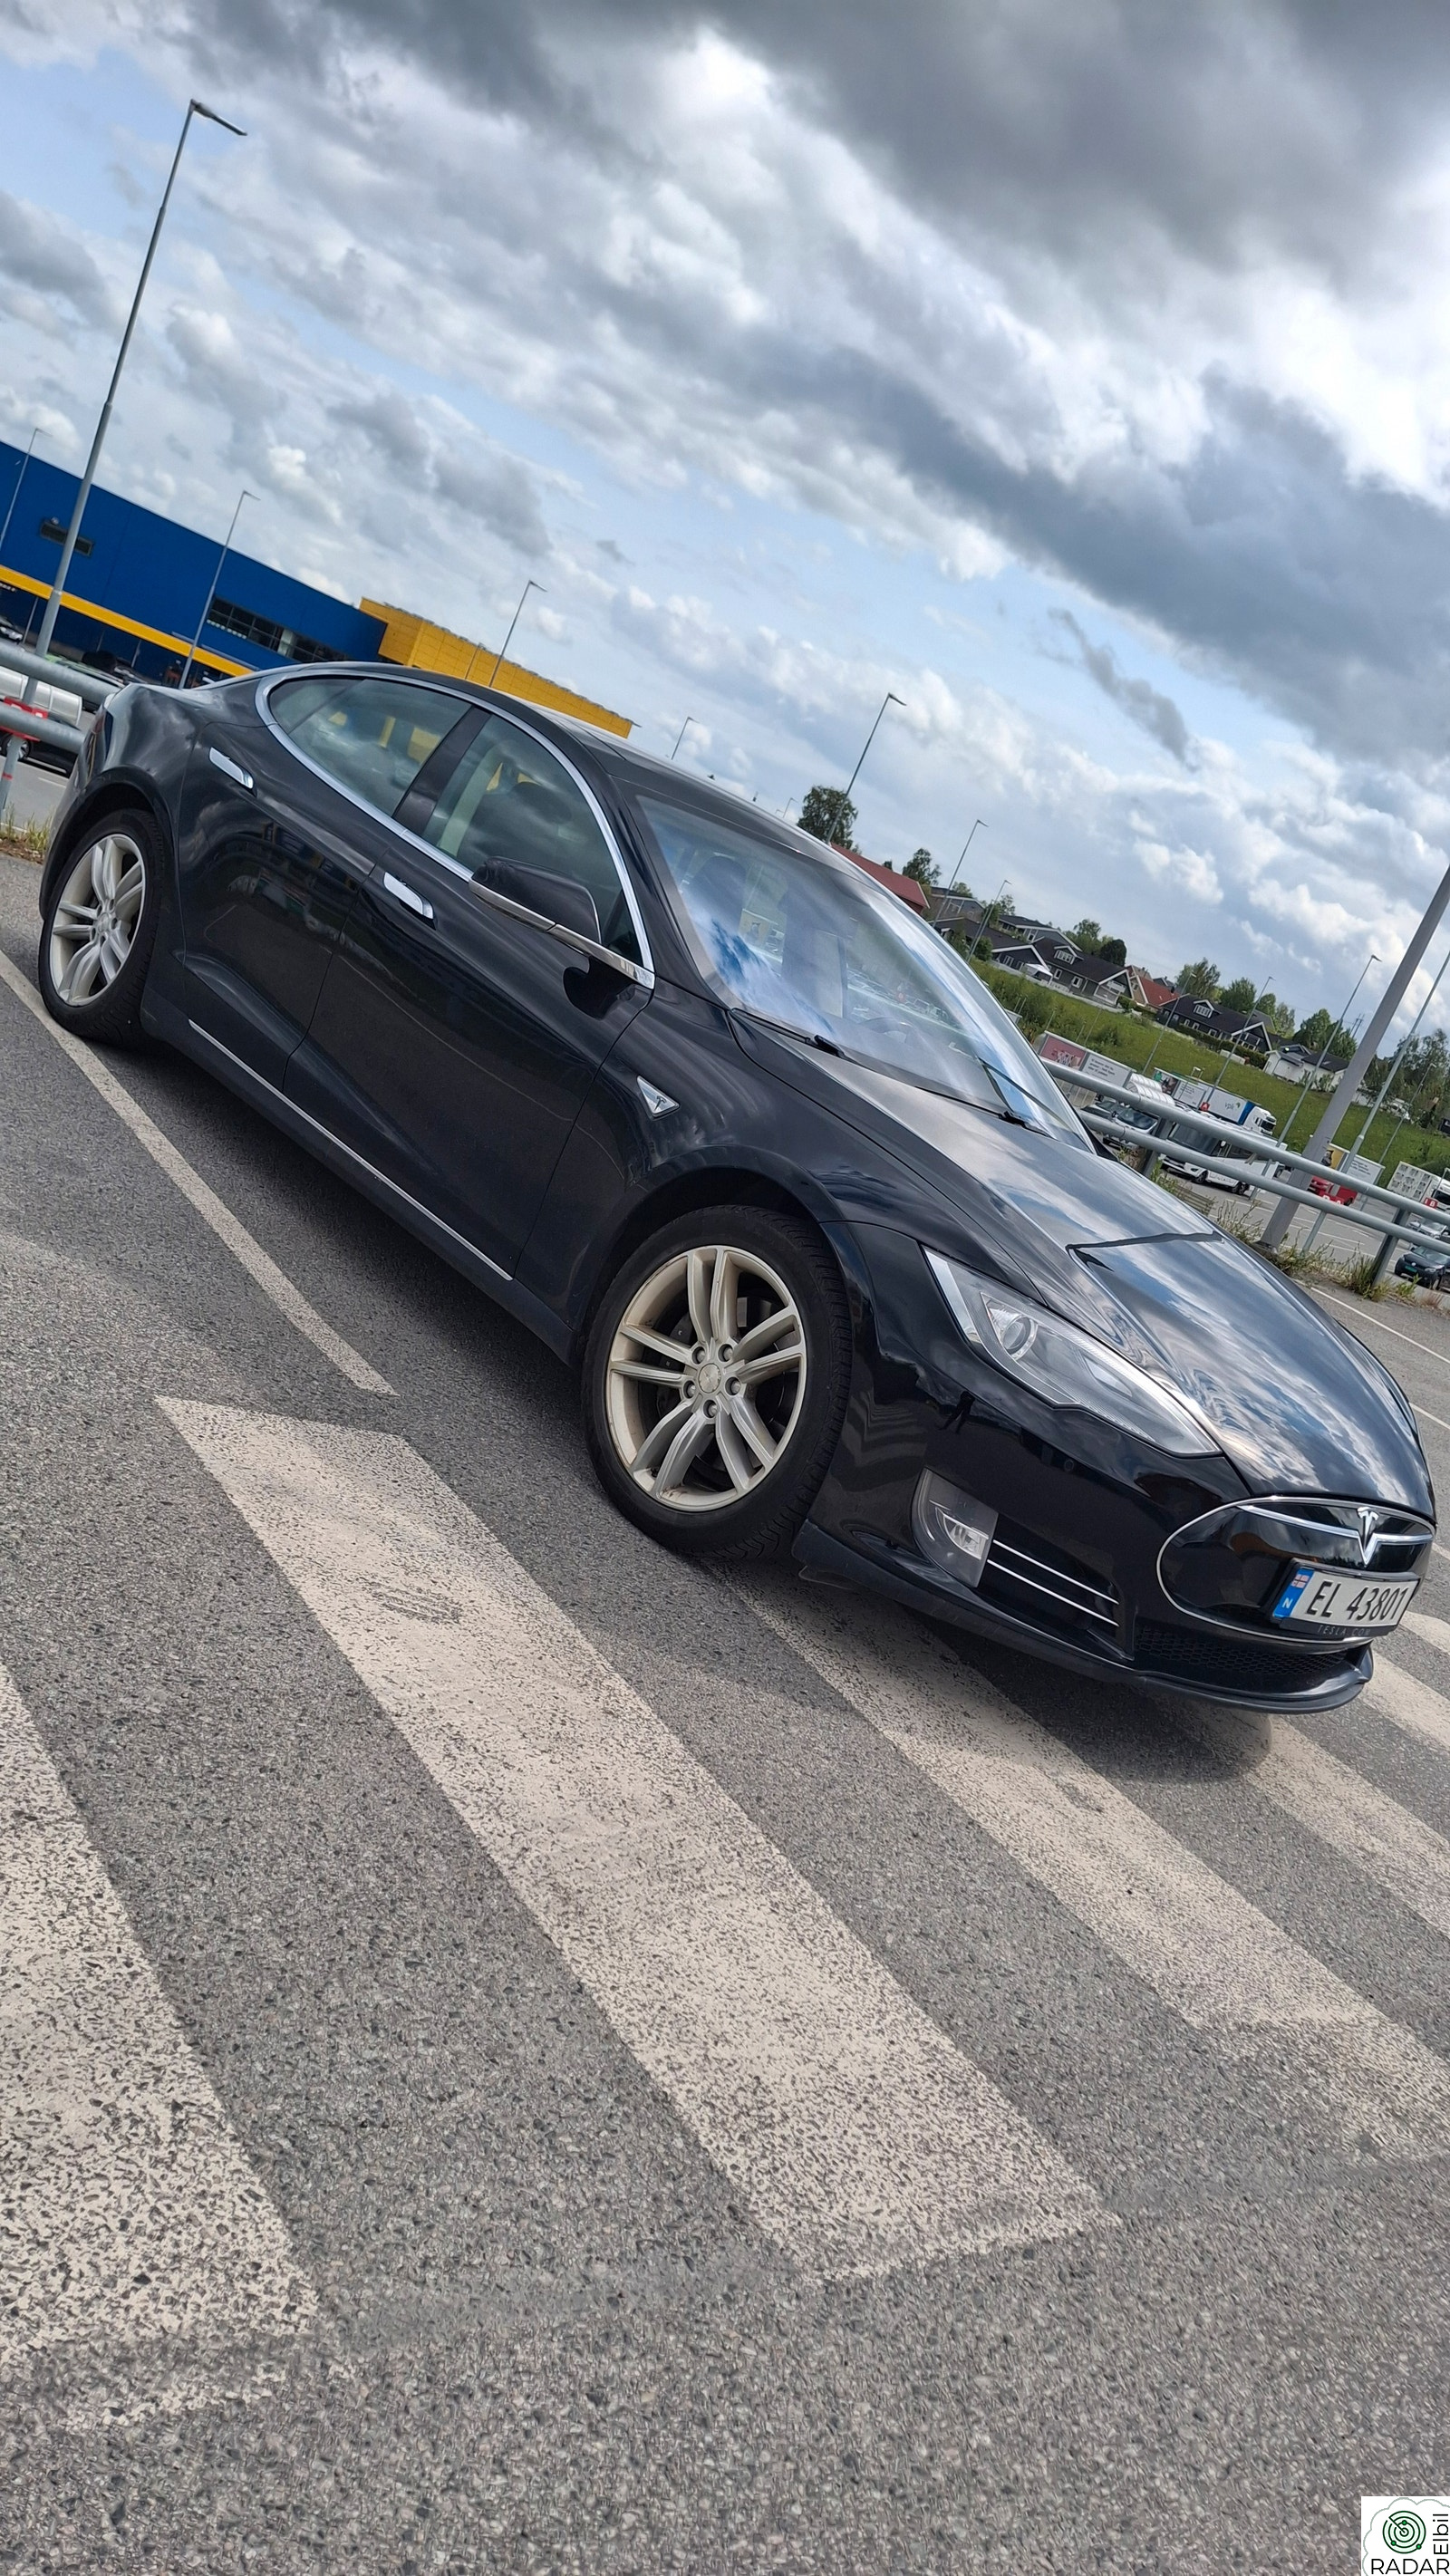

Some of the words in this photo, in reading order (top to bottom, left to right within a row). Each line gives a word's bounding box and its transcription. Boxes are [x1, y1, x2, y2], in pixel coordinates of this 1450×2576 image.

[1281, 1597, 1294, 1609] N
[1306, 1580, 1341, 1618] EL
[1347, 1587, 1409, 1621] 43801
